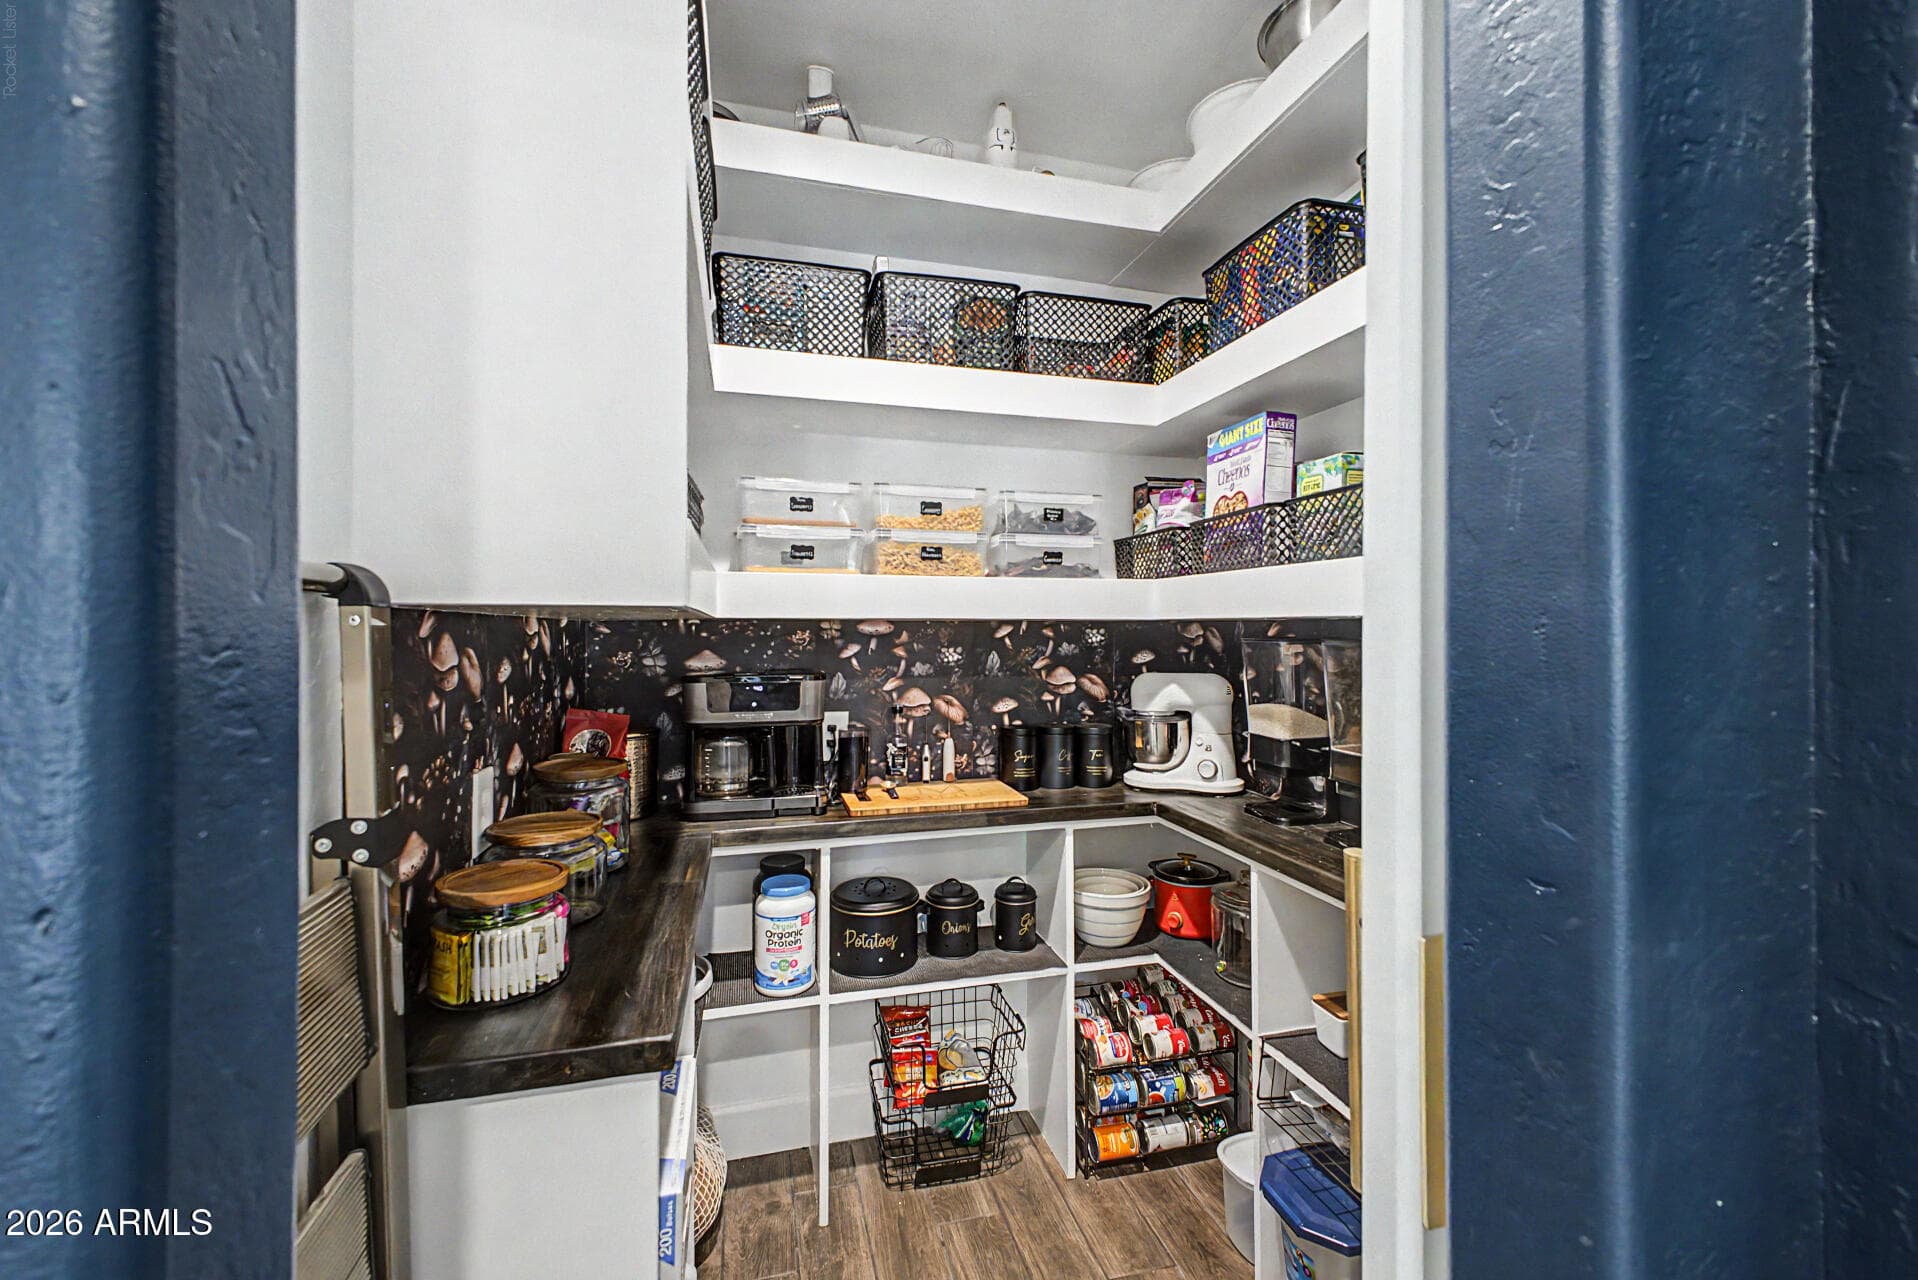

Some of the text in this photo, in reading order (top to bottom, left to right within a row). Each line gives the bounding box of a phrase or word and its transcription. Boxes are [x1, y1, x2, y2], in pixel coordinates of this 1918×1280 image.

[1219, 425, 1244, 447] GIANT
[1244, 417, 1264, 438] SIZE
[765, 928, 804, 940] Organic
[767, 937, 802, 948] Protein
[844, 928, 899, 950] Potatoes
[659, 1228, 673, 1257] 200
